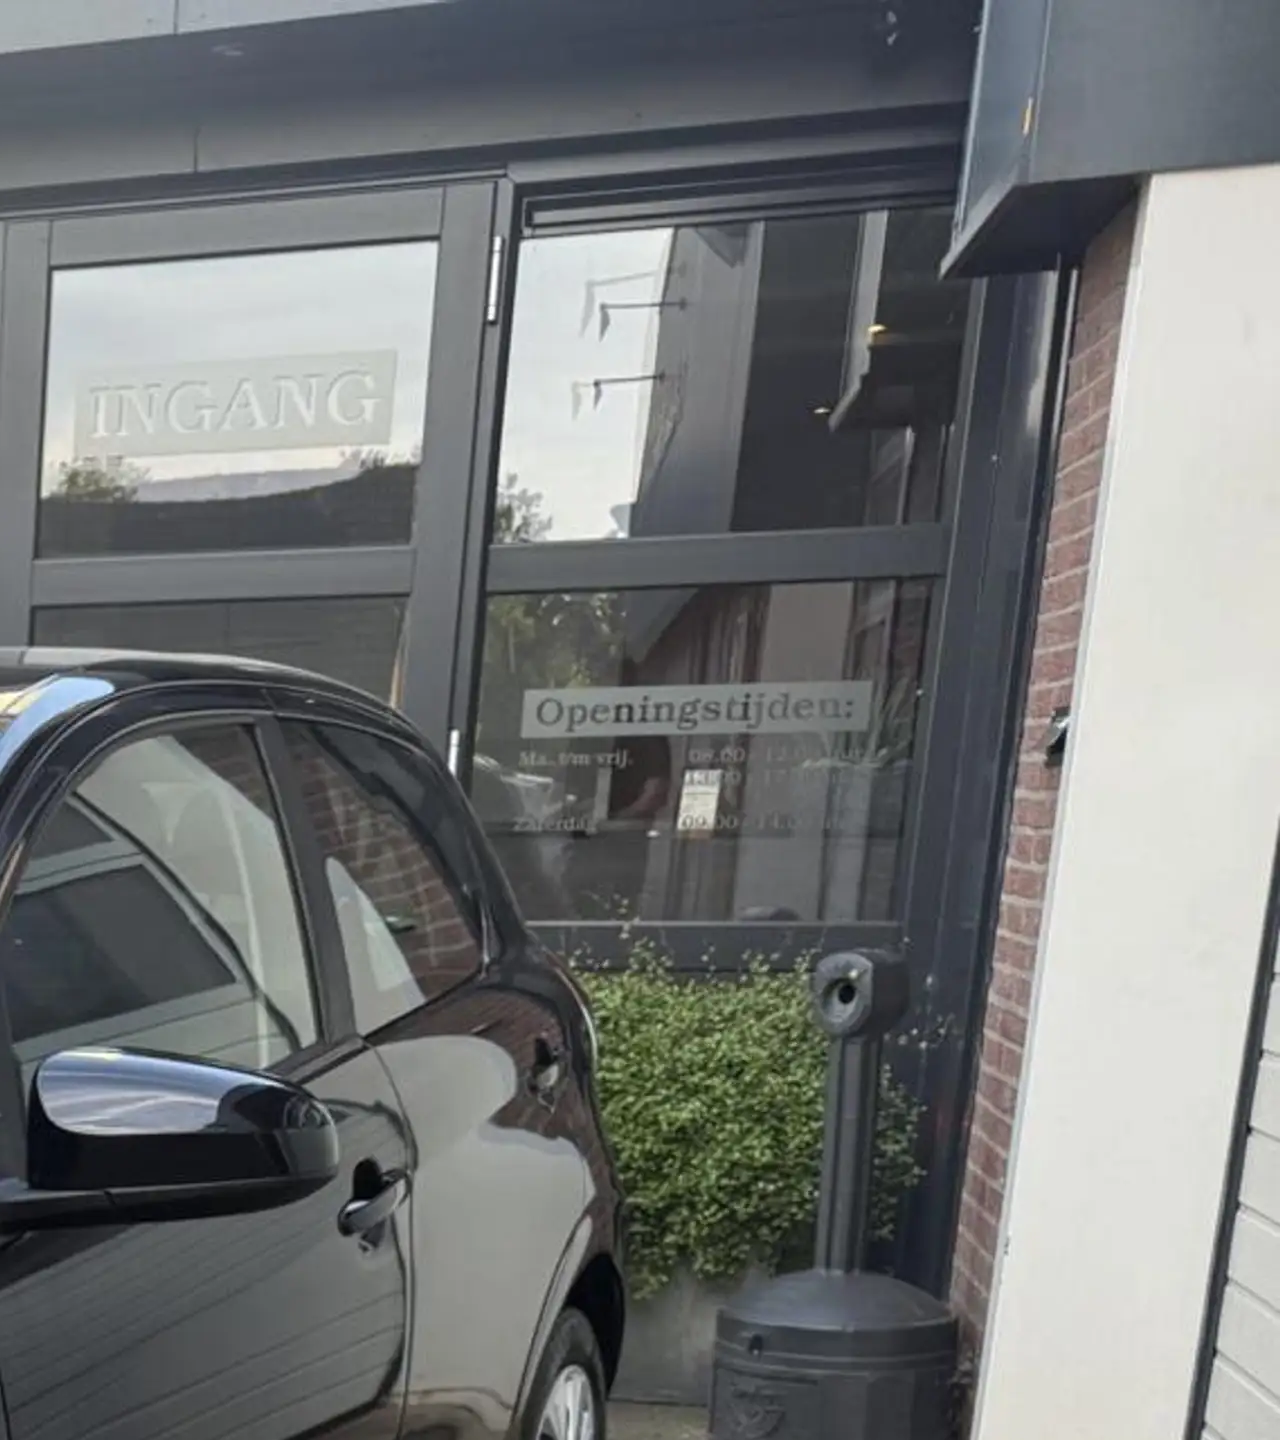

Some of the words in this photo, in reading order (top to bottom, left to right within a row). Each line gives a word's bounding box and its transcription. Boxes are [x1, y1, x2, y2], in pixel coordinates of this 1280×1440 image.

[90, 369, 381, 438] INGANG
[537, 691, 854, 732] Openingstijden:
[595, 748, 634, 769] vrij.
